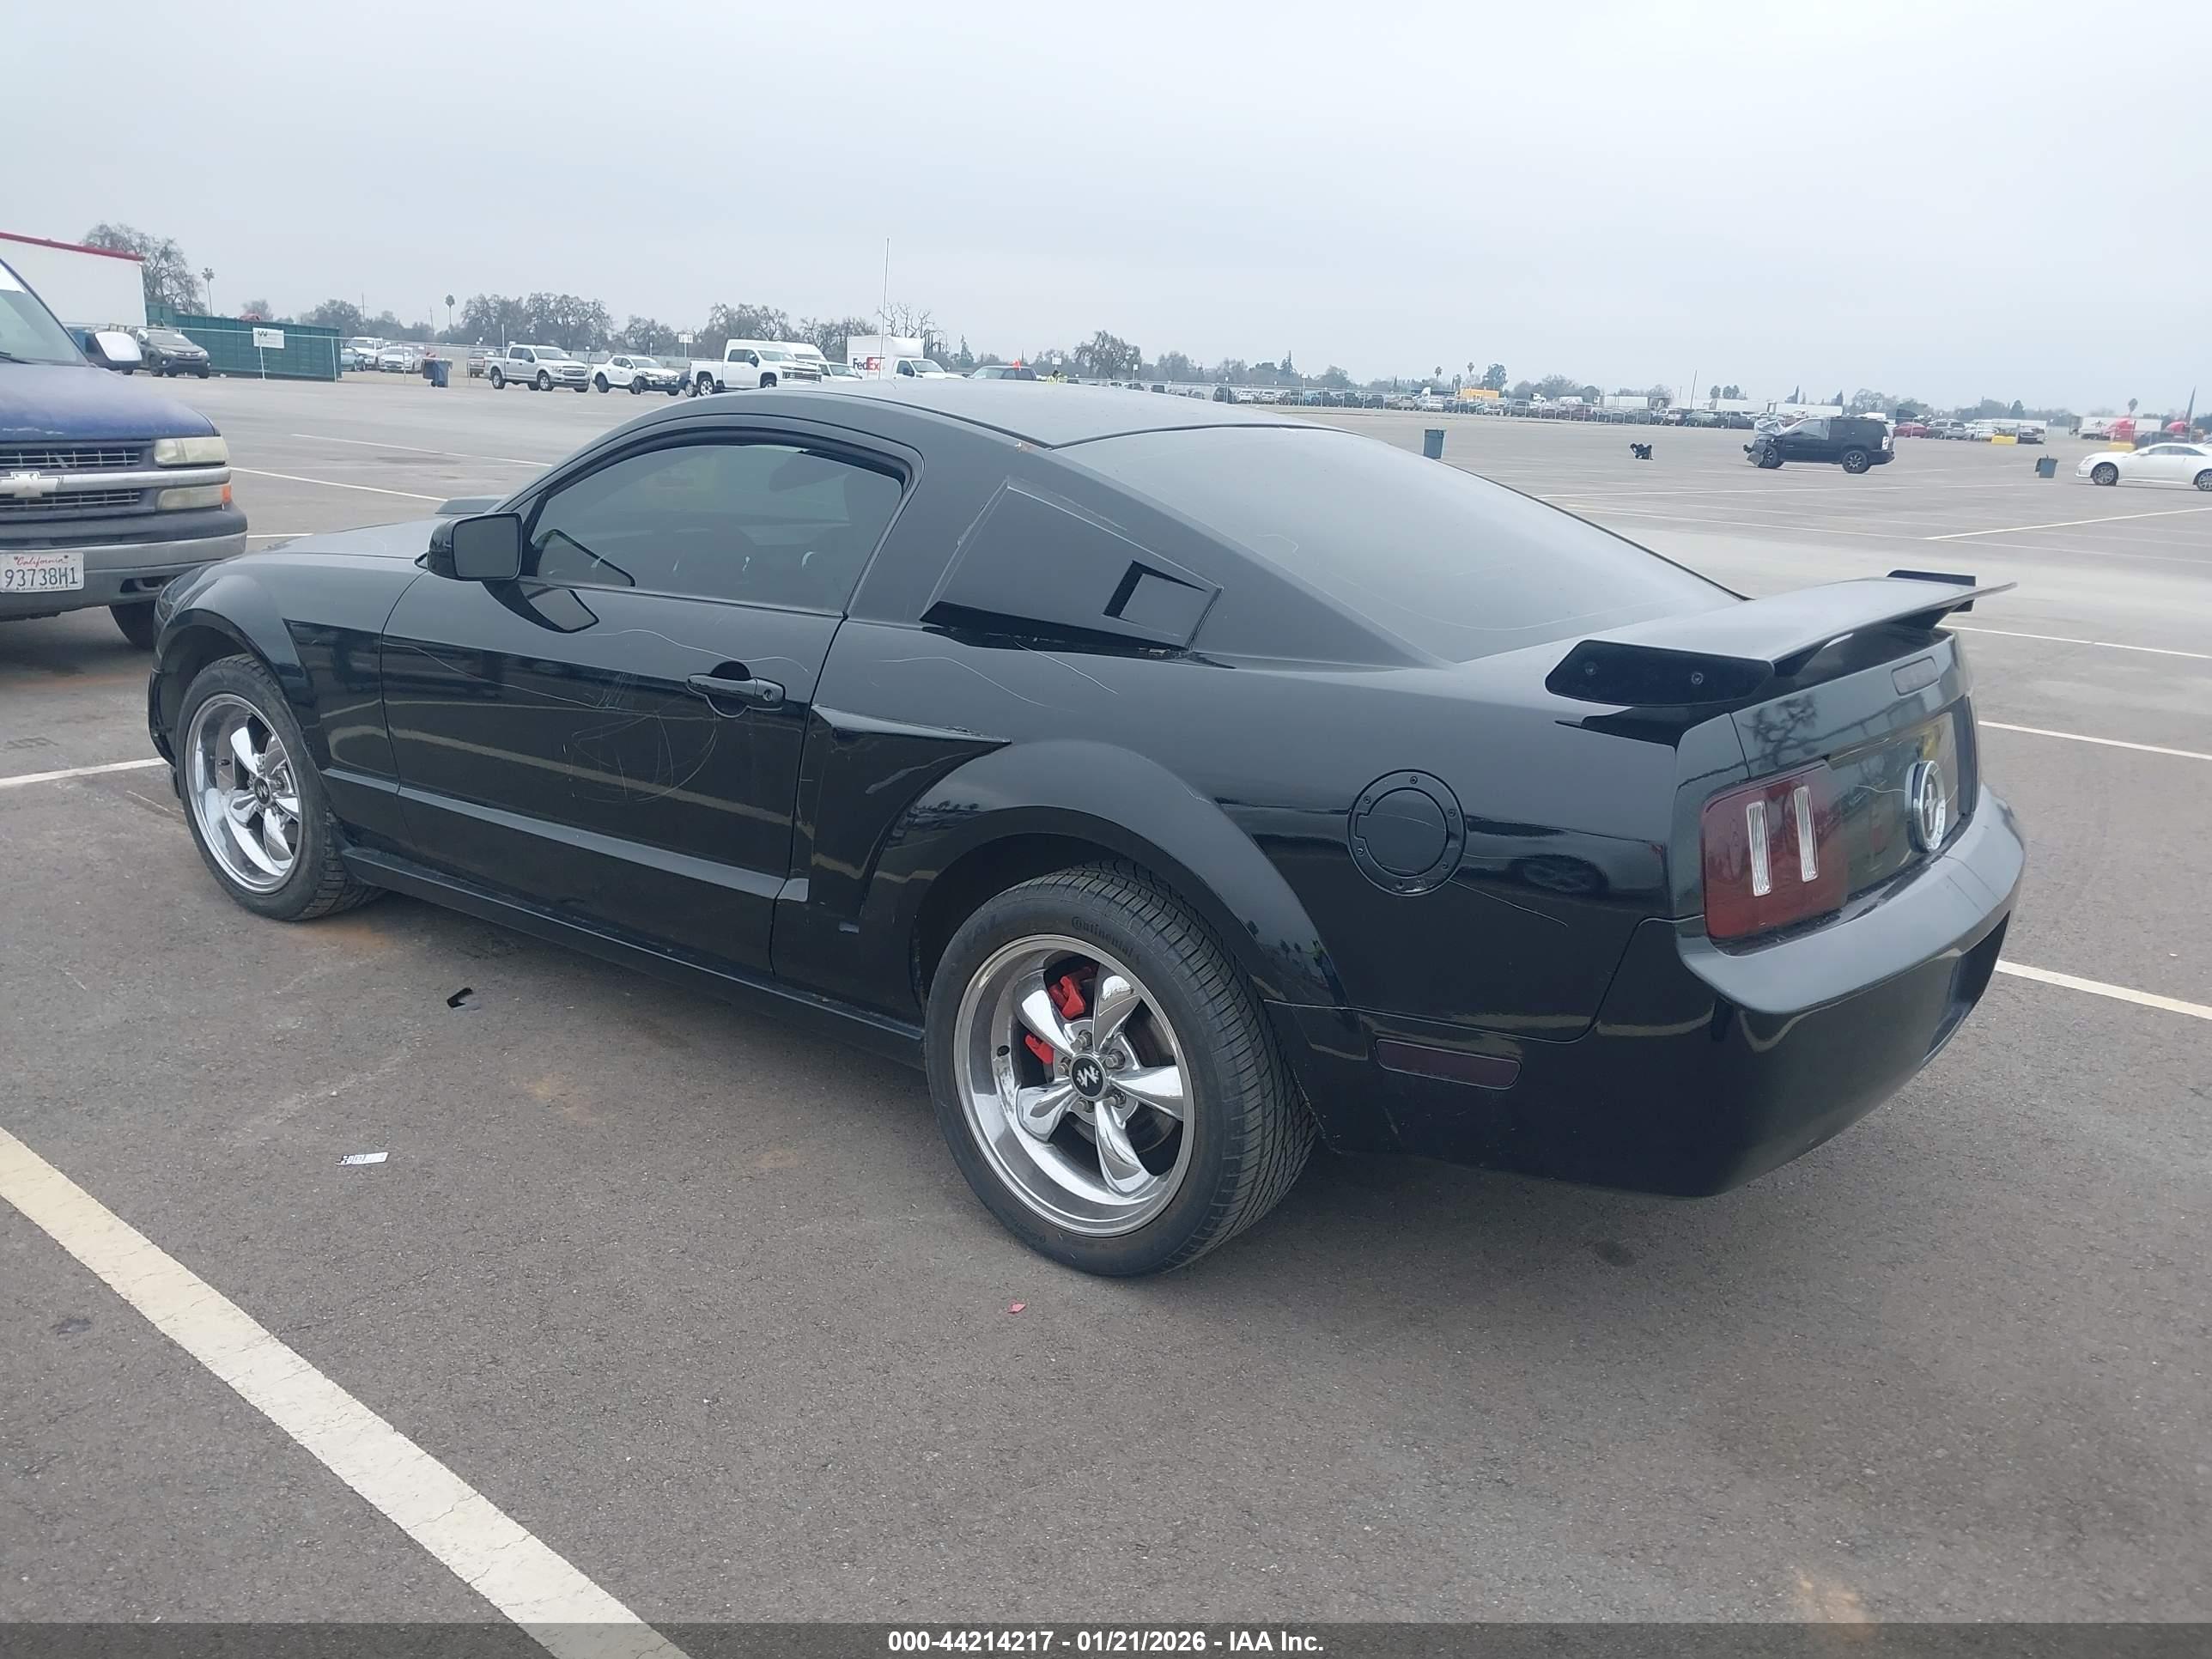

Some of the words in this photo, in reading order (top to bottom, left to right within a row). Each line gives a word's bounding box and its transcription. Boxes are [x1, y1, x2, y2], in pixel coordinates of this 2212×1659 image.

[853, 357, 880, 371] FedEx
[16, 556, 68, 568] California
[4, 567, 78, 587] 93738H1
